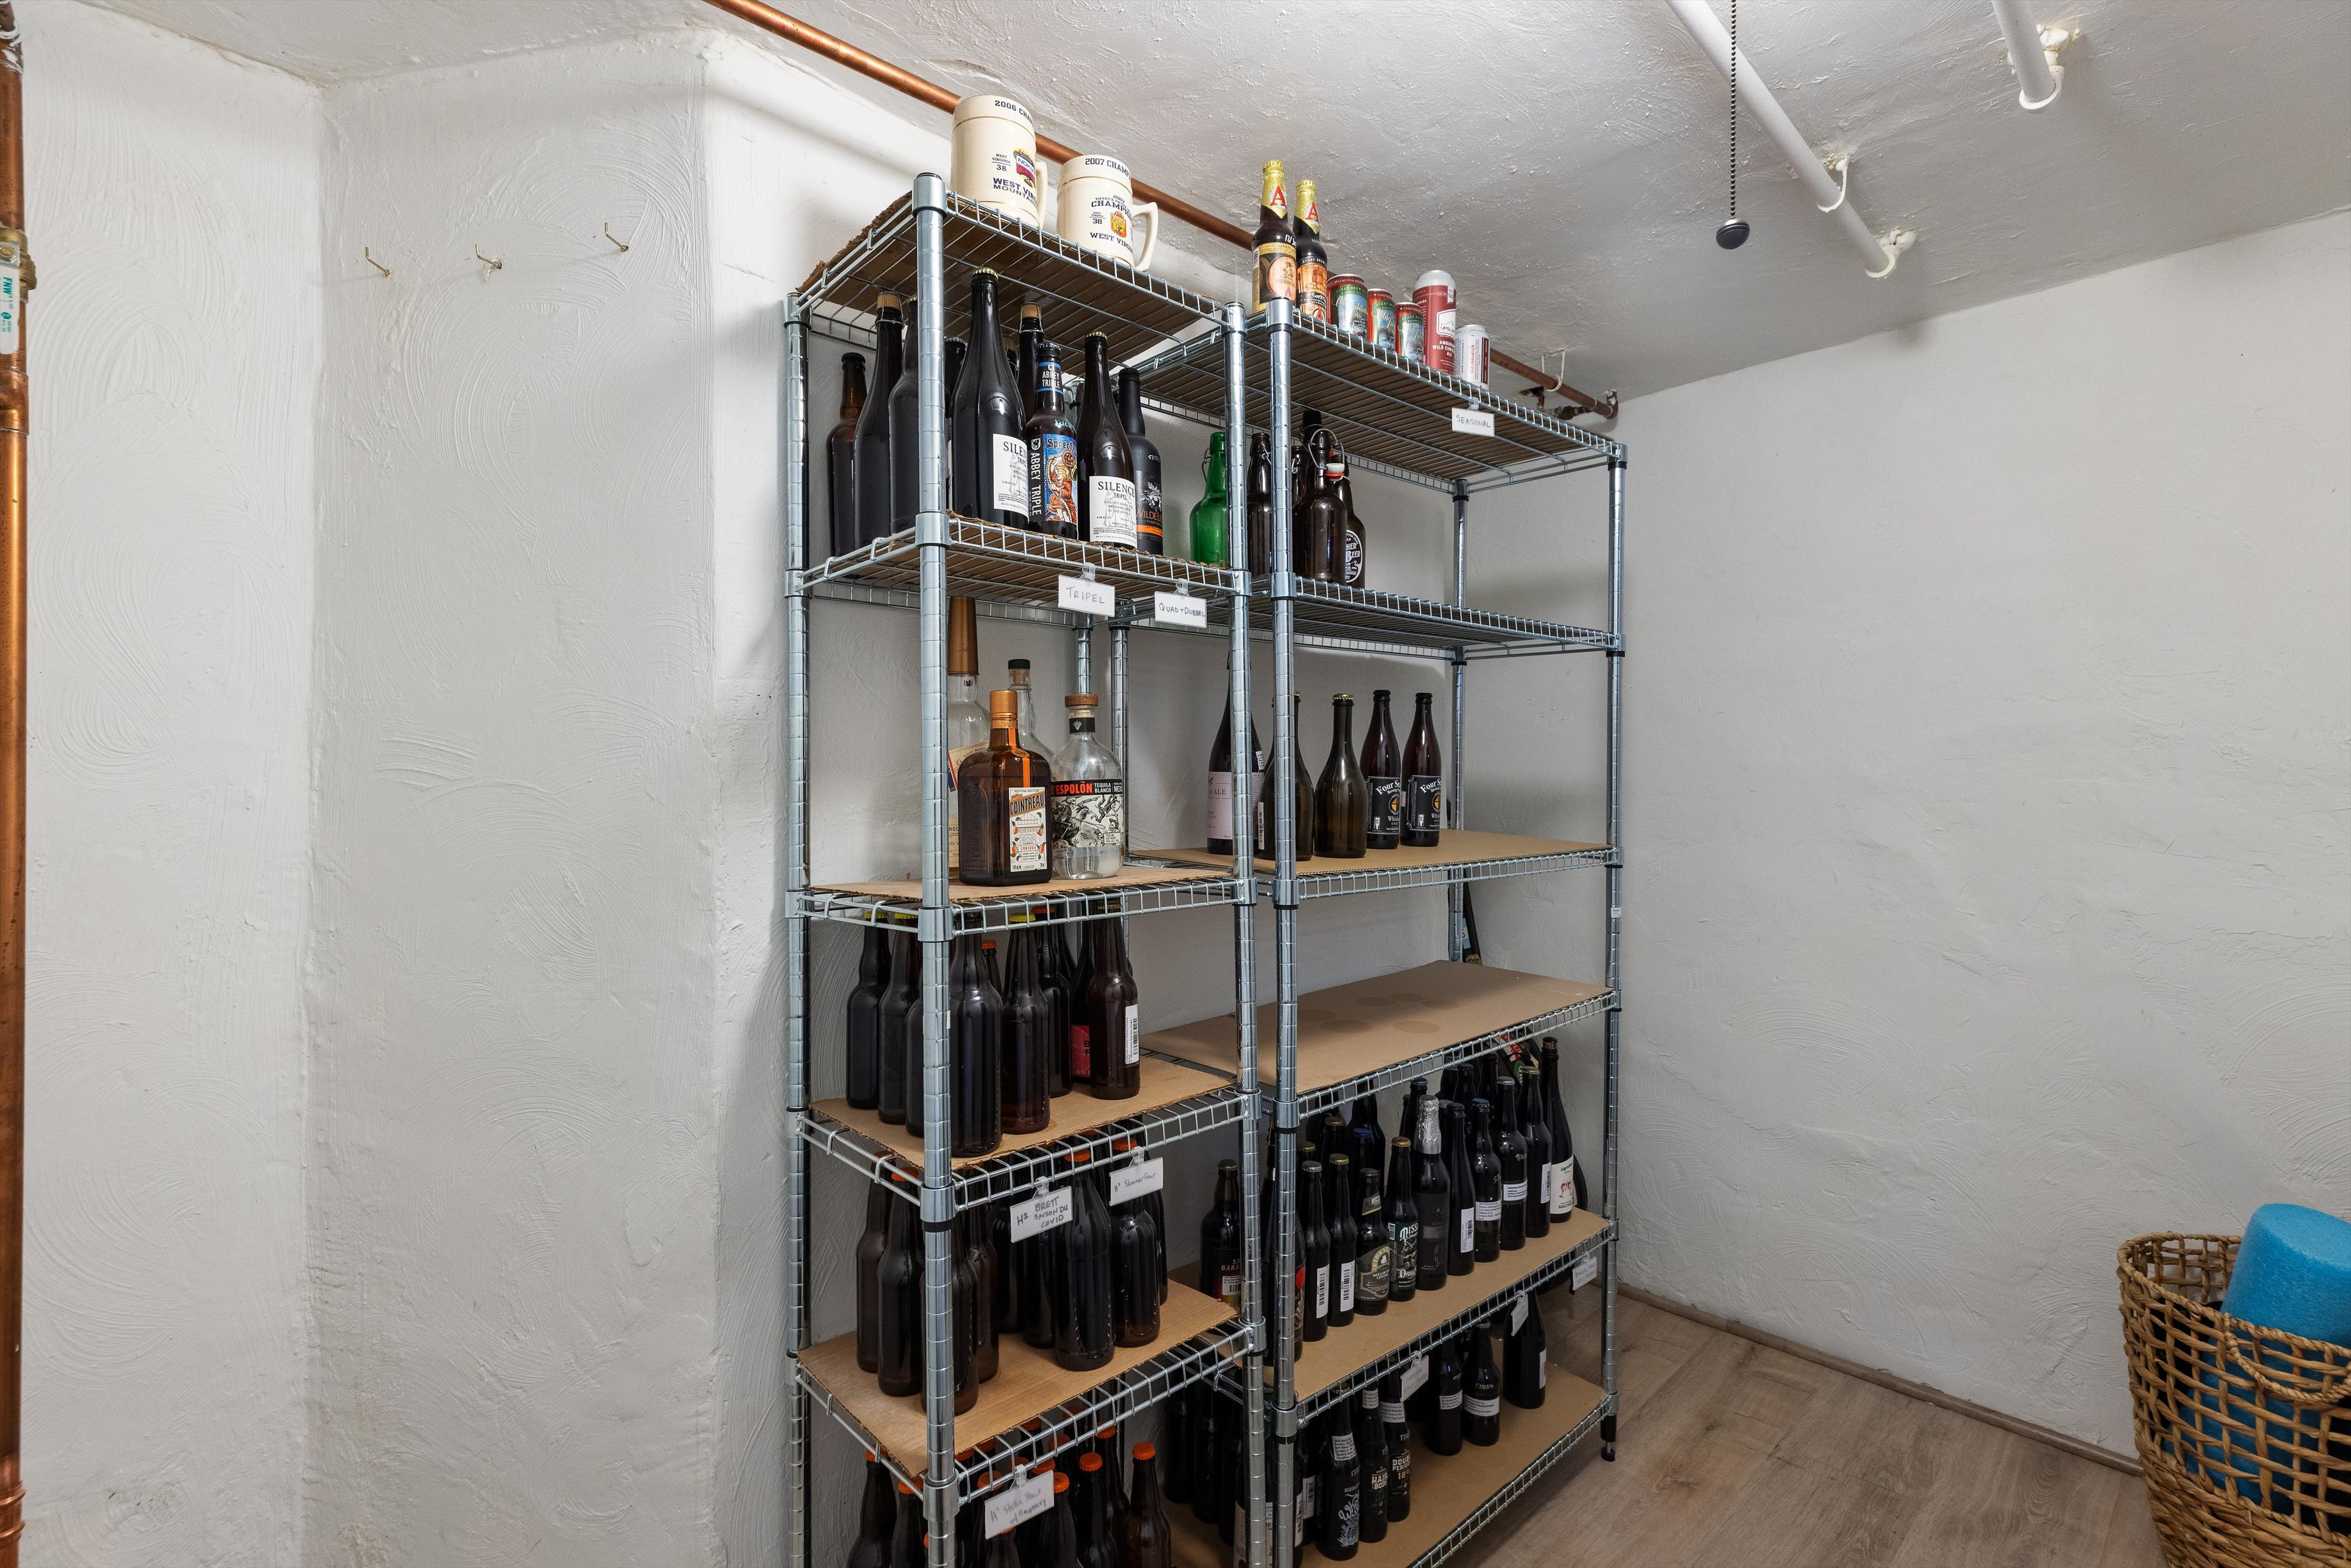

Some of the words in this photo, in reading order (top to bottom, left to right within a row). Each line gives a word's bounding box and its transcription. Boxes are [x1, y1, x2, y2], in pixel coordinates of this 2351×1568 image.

[994, 100, 1017, 111] 2006
[993, 177, 1021, 190] WEST
[1270, 185, 1287, 208] A
[1305, 203, 1319, 224] A
[1090, 232, 1114, 242] WEST
[2, 276, 13, 295] FNW
[1041, 371, 1060, 381] ABBEY
[1456, 414, 1492, 428] SEASONAL
[1030, 453, 1041, 480] ABBEY
[1098, 481, 1135, 497] SILENCE
[1031, 484, 1042, 516] TRIPLE
[1345, 551, 1361, 563] BEER
[1066, 587, 1106, 604] TRIPEL
[1375, 782, 1394, 795] Four
[1419, 781, 1436, 793] Four
[1010, 793, 1044, 815] COINTREAU
[1033, 1208, 1058, 1220] SAISON
[1060, 1204, 1069, 1213] DU
[1034, 1196, 1059, 1212] BRETT
[1041, 1214, 1064, 1228] COVID
